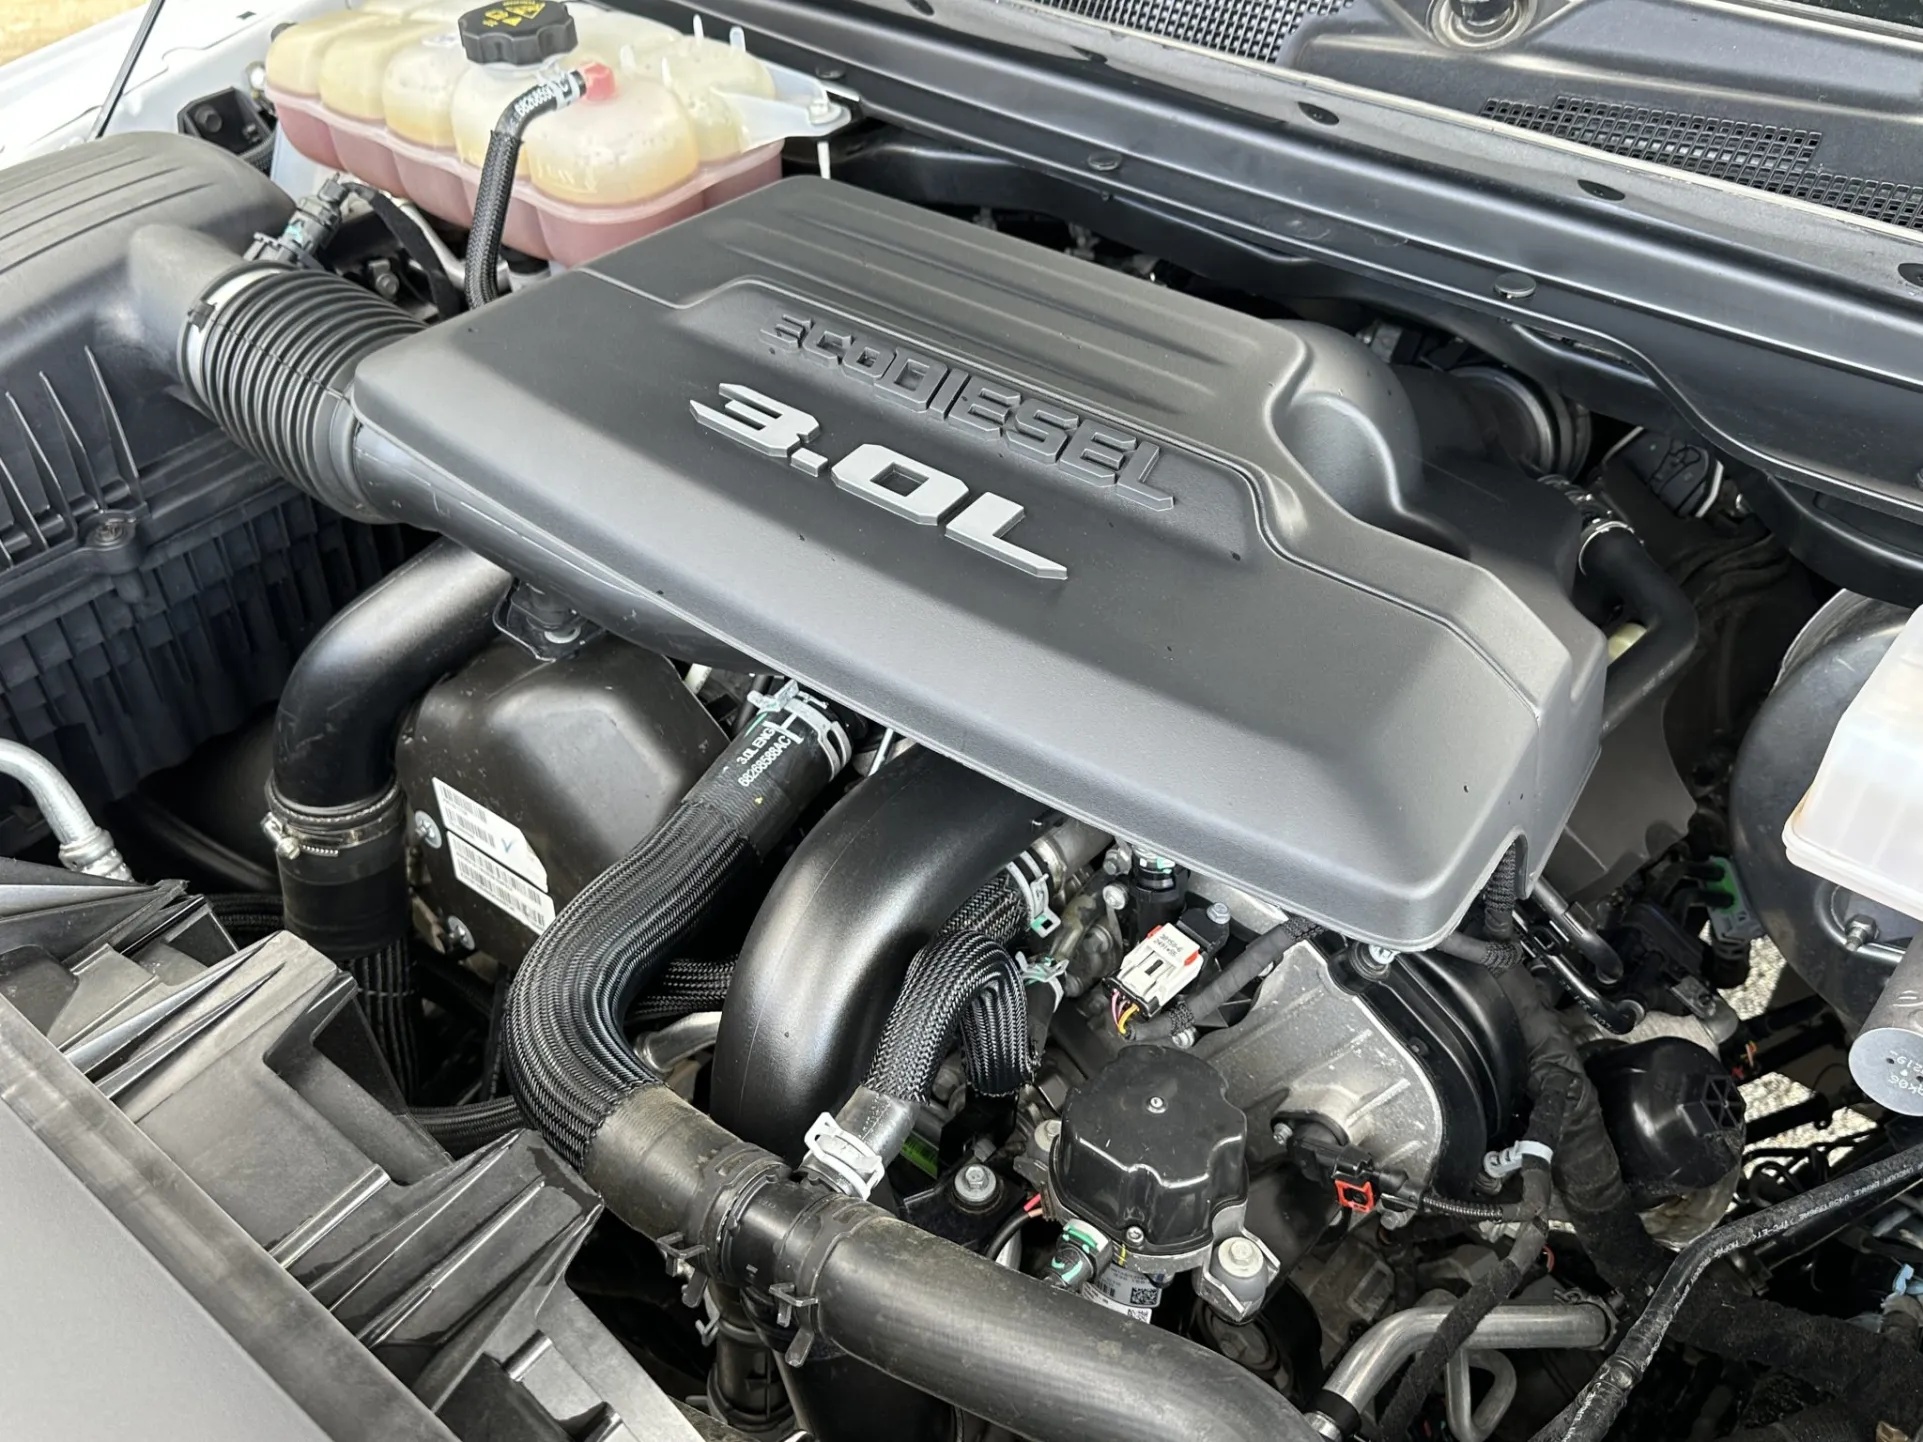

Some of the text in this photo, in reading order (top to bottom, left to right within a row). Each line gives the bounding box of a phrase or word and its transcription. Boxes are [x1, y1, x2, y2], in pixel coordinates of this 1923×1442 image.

[690, 383, 1068, 580] 3.0L
[736, 727, 776, 765] 3.0L ENG
[738, 735, 792, 787] 68268588AC
